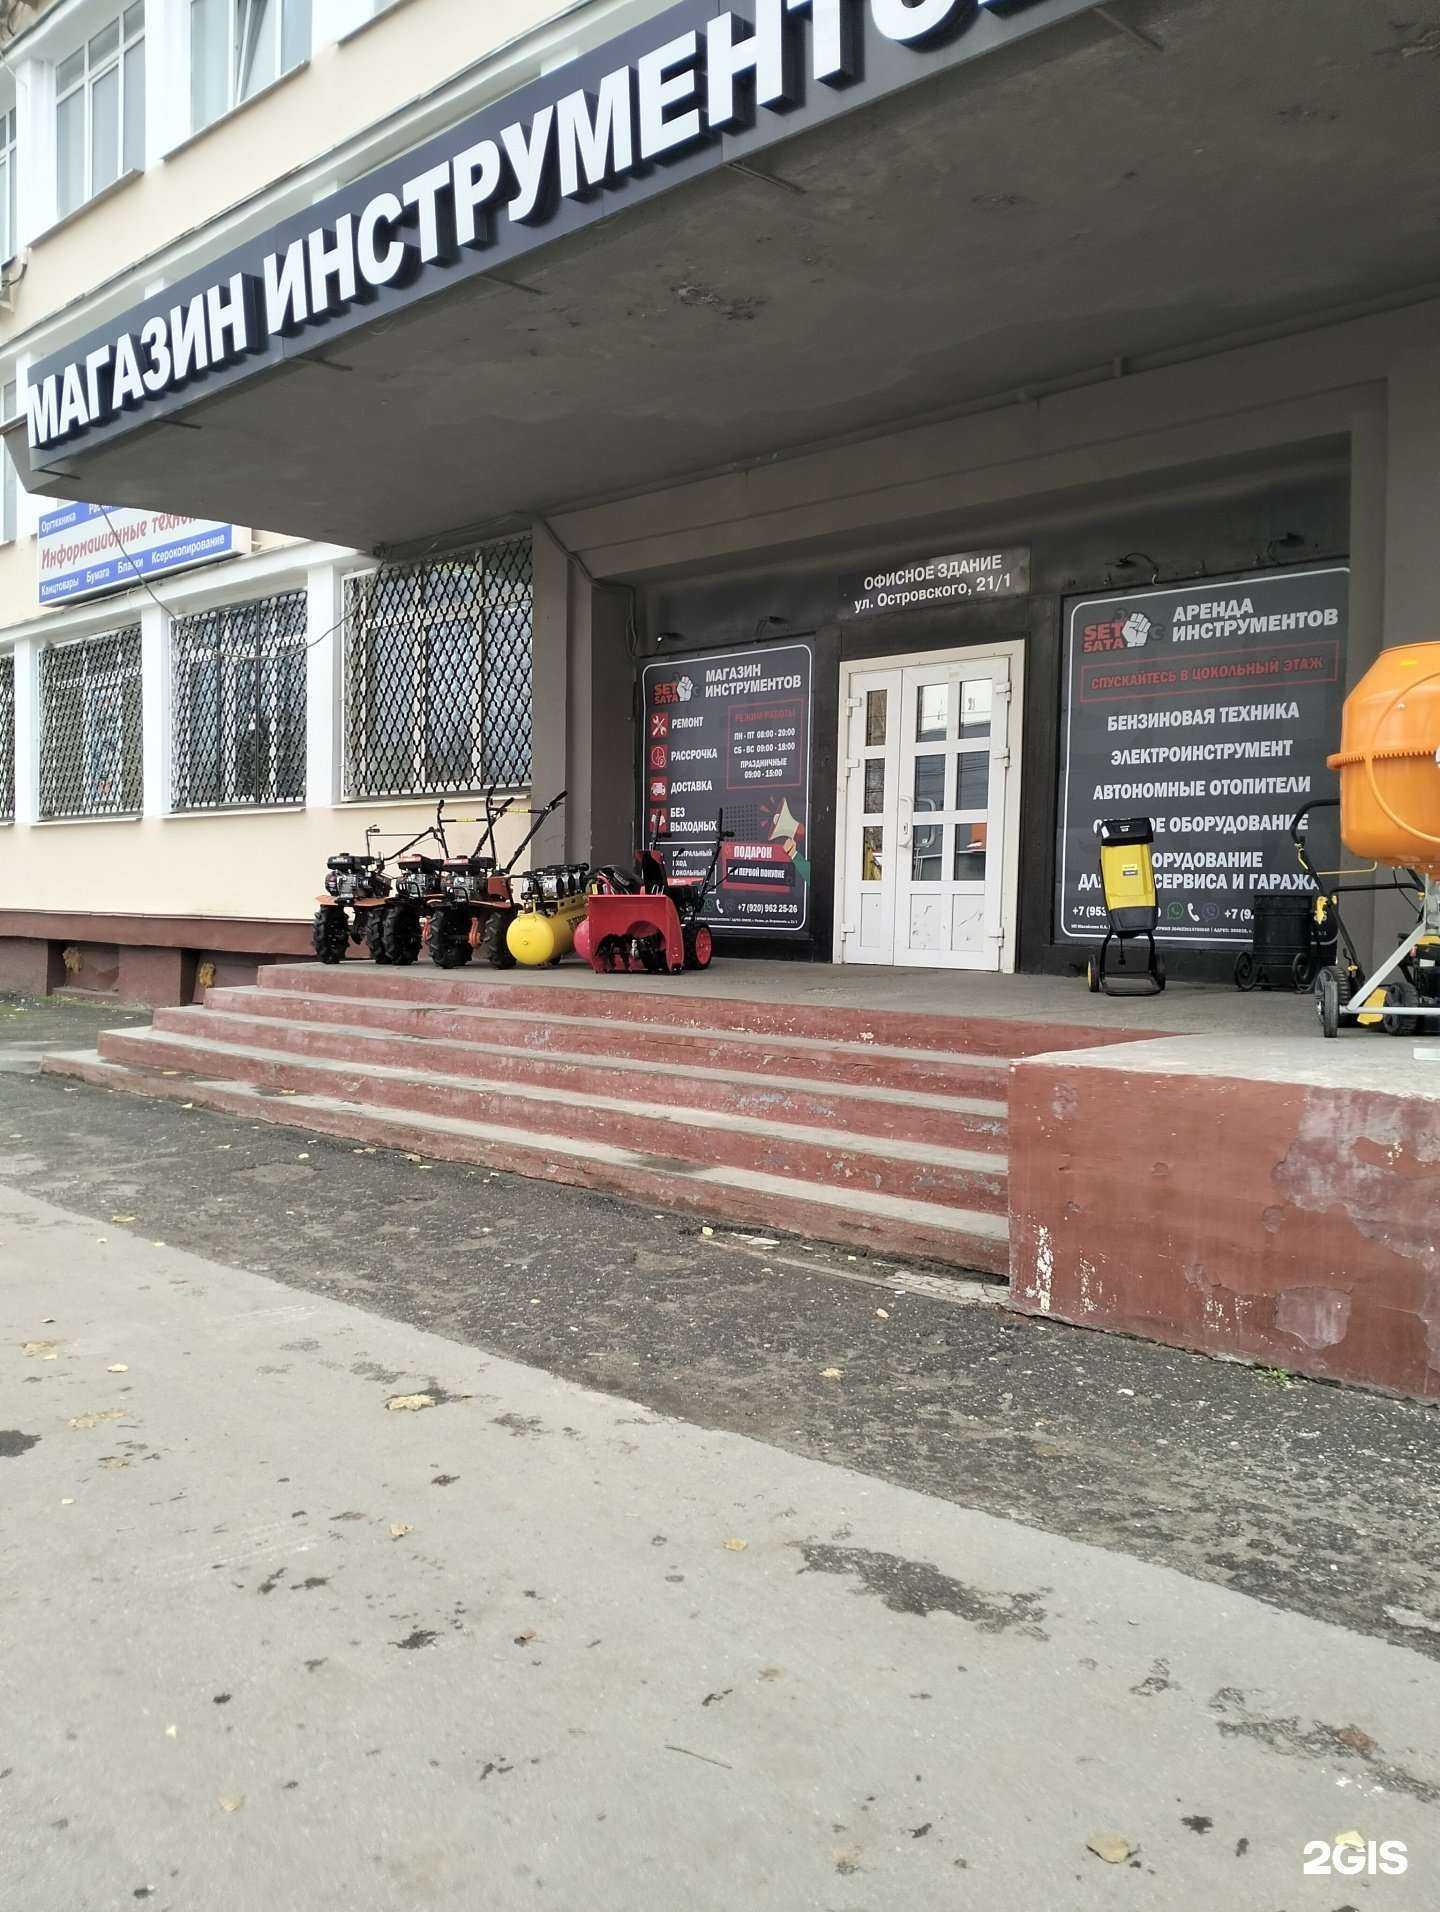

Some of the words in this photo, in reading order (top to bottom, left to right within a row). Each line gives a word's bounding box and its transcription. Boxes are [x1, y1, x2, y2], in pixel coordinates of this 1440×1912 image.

[27, 270, 248, 448] МАГАЗИН
[263, 0, 1000, 336] ИНСТРУМЕНТ
[41, 519, 148, 570] Информационные
[41, 577, 80, 596] Канцтовары
[86, 567, 110, 584] Бумага
[117, 557, 144, 574] Бланки
[151, 533, 225, 564] Ксерокопирование
[863, 565, 935, 591] ОФИСНОЕ
[937, 554, 1003, 579] ЗДАНИЕ
[854, 599, 873, 613] ул.
[876, 582, 972, 607] Островского,
[976, 573, 1011, 593] 21/1
[1172, 597, 1254, 623] АРЕНДА
[1083, 621, 1124, 642] SET
[1171, 608, 1339, 643] ИНСТРУМЕНТОВ
[1083, 638, 1124, 653] SATA
[705, 663, 762, 683] МАГАЗИН
[1091, 668, 1177, 690] СПУСКАЙТЕСЬ
[1180, 670, 1189, 682] В
[1192, 658, 1280, 681] ЦОКОЛЬНЫЙ
[1283, 655, 1324, 672] ЭТАЖ
[705, 674, 802, 698] ИНСТРУМЕНТОВ
[671, 716, 704, 729] РЕМОНТ
[1107, 706, 1216, 732] БЕНЗИНОВАЯ
[1219, 701, 1300, 724] ТЕХНИКА
[734, 732, 743, 740] ПН
[747, 731, 755, 739] ПТ
[778, 728, 795, 736] 20:00
[670, 748, 718, 761] РАССРОЧКА
[733, 746, 742, 754] СБ
[757, 744, 773, 752] 09:00
[778, 742, 795, 751] 18:00
[1110, 739, 1294, 766] ЭЛЕКТРОИНСТРУМЕНТ
[740, 758, 788, 769] ПРАЗДНИЧНЫЕ
[744, 770, 761, 779] 09:00
[765, 769, 783, 778] 15:00
[670, 780, 713, 794] ДОСТАВКА
[1093, 780, 1206, 801] АВТОНОМНЫЕ
[1209, 775, 1311, 796] ОТОПИТЕЛИ
[670, 807, 686, 818] БЕЗ
[670, 820, 717, 833] ВЫХОДНЫХ
[1170, 813, 1310, 834] ОБОРУДОВАНИЕ
[672, 849, 713, 858] ЦТРАЛЬНЫЙ
[734, 845, 773, 860] ПОДАРОК
[1151, 851, 1264, 869] ОРУДОВАНИЕ
[1078, 873, 1102, 891] ДЛ
[1231, 873, 1245, 890] И
[1248, 873, 1321, 891] ГАРАЖА
[737, 904, 746, 912] +7
[746, 904, 764, 914] (920)
[764, 903, 778, 913] 962
[778, 904, 798, 914] 25-26
[1072, 906, 1085, 916] +7
[1224, 909, 1237, 920] +7
